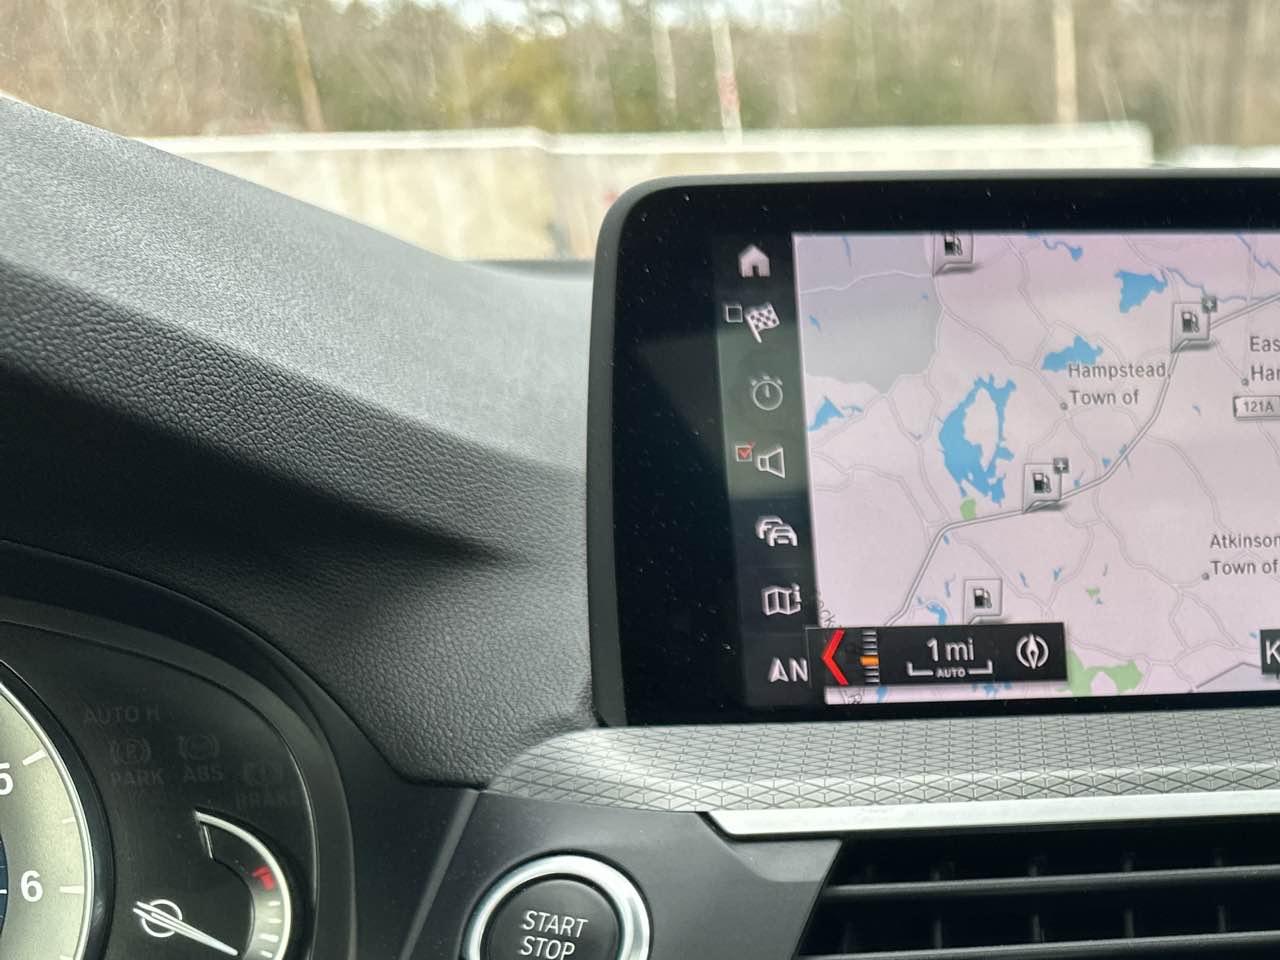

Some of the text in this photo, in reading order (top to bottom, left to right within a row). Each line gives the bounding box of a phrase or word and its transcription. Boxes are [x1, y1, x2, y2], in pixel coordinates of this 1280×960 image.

[1069, 389, 1139, 405] Town of
[1244, 402, 1274, 413] 121A
[1210, 559, 1278, 575] Town of
[927, 637, 975, 662] 1 mi
[935, 668, 967, 679] AUTO
[20, 870, 43, 903] 6
[523, 910, 588, 938] START
[520, 936, 575, 960] STOP
